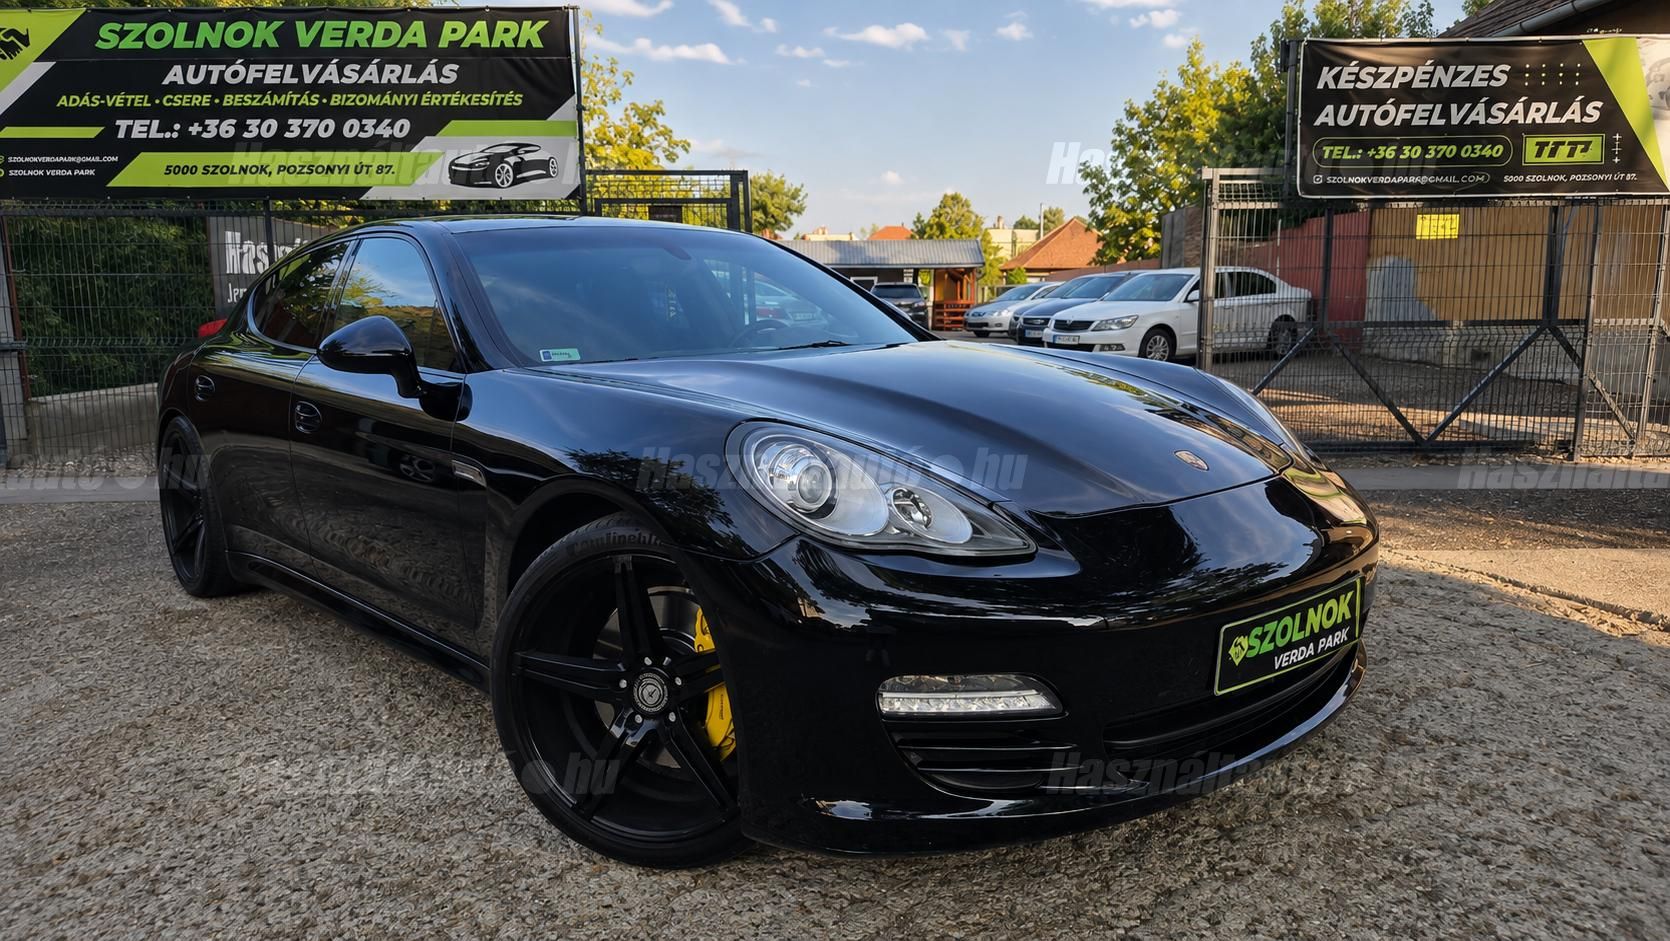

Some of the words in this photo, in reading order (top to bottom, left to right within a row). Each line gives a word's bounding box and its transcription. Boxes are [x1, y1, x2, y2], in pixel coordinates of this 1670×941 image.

[95, 20, 285, 49] SZOLNOK
[295, 20, 428, 48] VERDA
[438, 20, 550, 48] PARK
[162, 58, 460, 85] AUTÓFELVÁSÁRLÁS
[1316, 59, 1511, 89] KÉSZPÉNZES
[57, 91, 151, 107] ADÁS-VÉTEL
[162, 93, 211, 107] CSERE
[222, 90, 320, 107] BESZÁMÍTÁS
[330, 90, 418, 106] BIZOMÁNYI
[420, 90, 524, 106] ÉRTÉKESÍTÉS
[1314, 95, 1604, 127] AUTÓFELVÁSÁRLÁS
[115, 119, 181, 139] TEL.:
[188, 119, 236, 138] +36
[242, 119, 279, 138] 30
[284, 118, 335, 138] 370
[342, 118, 411, 138] 0340
[1322, 145, 1363, 160] TEL.:
[1367, 145, 1396, 160] +36
[1400, 145, 1421, 159] 30
[1425, 145, 1459, 159] 370
[1461, 144, 1504, 159] 0340
[8, 169, 45, 177] SZOLNOK
[74, 168, 96, 176] PARK
[164, 164, 198, 176] 5000
[201, 164, 273, 177] SZOLNOK,
[276, 164, 350, 175] POZSONYI
[354, 160, 373, 175] ÚT
[376, 164, 396, 175] 87.
[1503, 174, 1524, 182] 5000
[1569, 173, 1612, 181] POZSONYI
[1613, 171, 1624, 180] ÚT
[1246, 591, 1354, 658] SZOLNOK
[1274, 642, 1314, 670] VERDA
[1317, 626, 1350, 653] PARK
